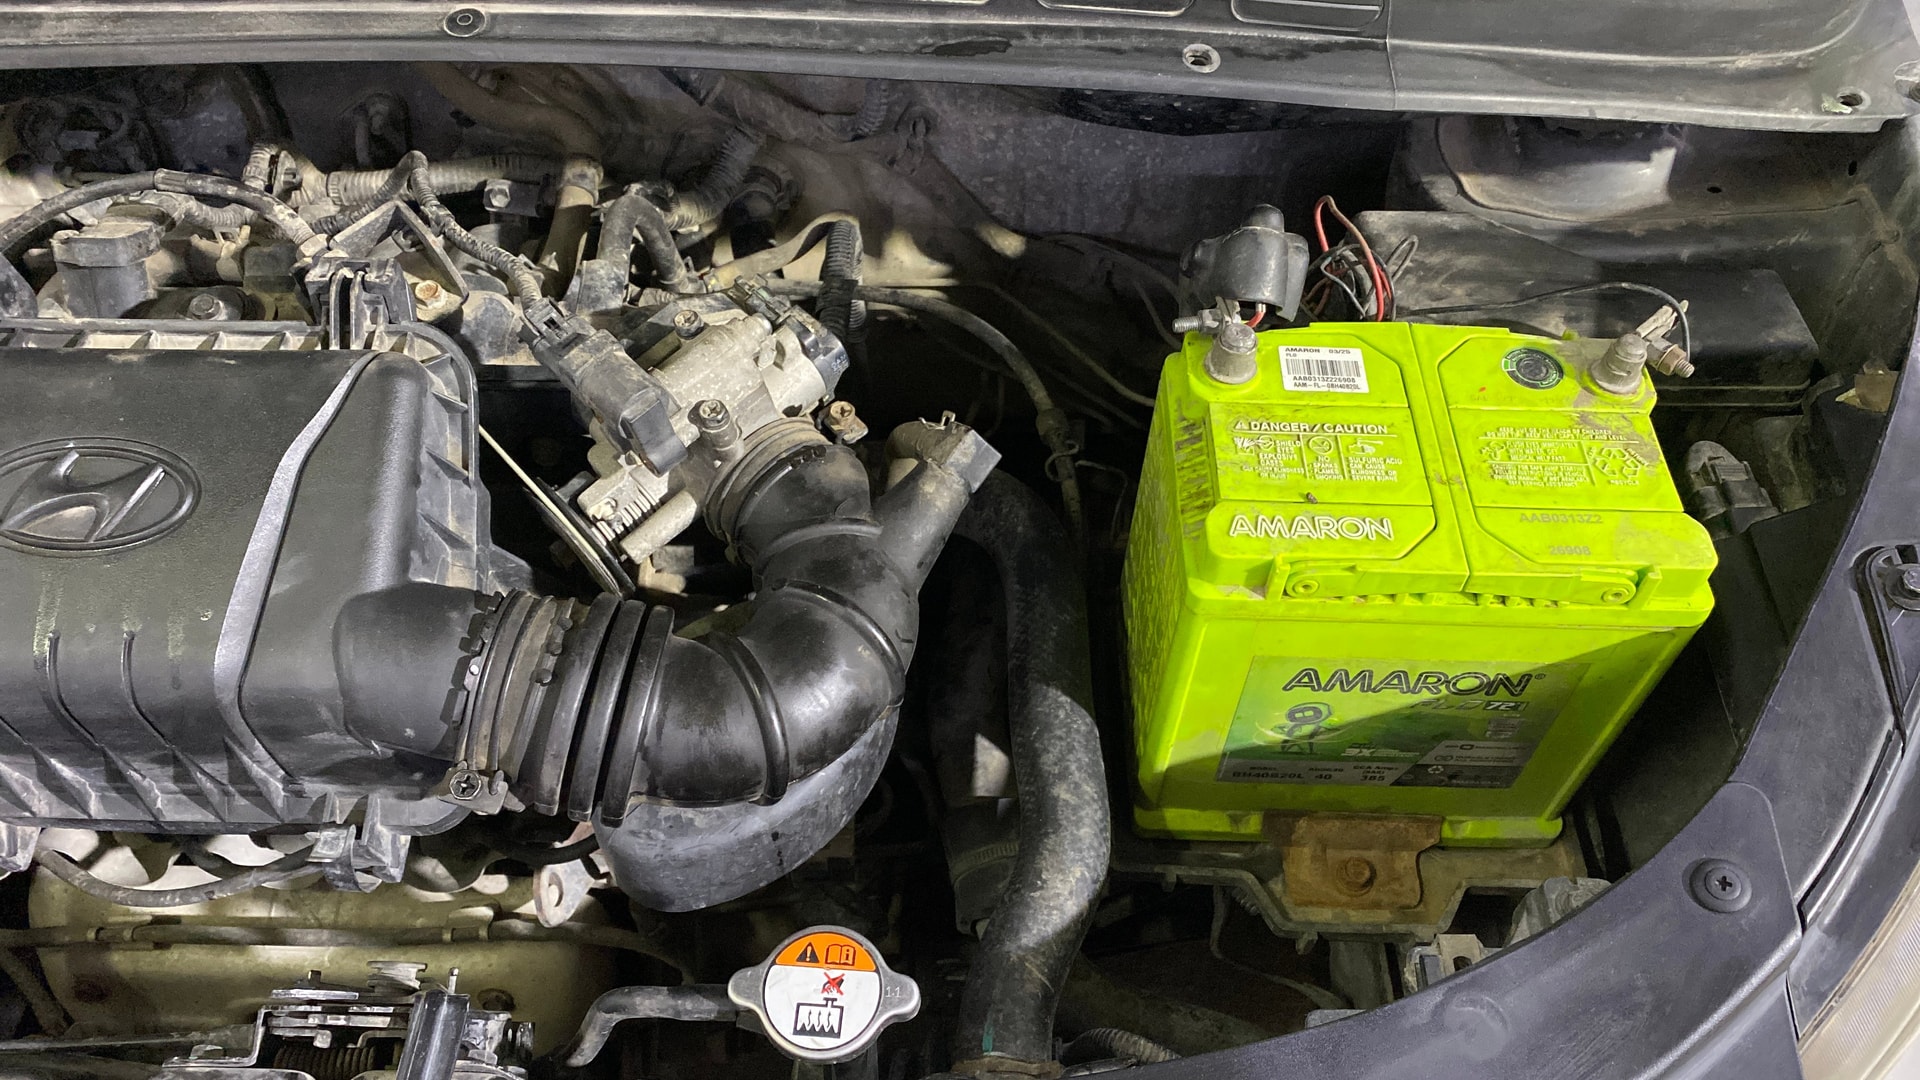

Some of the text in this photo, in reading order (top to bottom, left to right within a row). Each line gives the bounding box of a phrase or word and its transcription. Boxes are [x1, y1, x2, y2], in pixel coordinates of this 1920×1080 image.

[1249, 421, 1310, 432] DANGER
[1323, 423, 1388, 434] CAUTION
[1275, 440, 1301, 448] SHIELD
[1348, 456, 1403, 465] SULFURIC ACID
[1520, 513, 1604, 524] AAB0313Z2
[1229, 514, 1394, 541] AMARON
[1549, 545, 1591, 556] 26908
